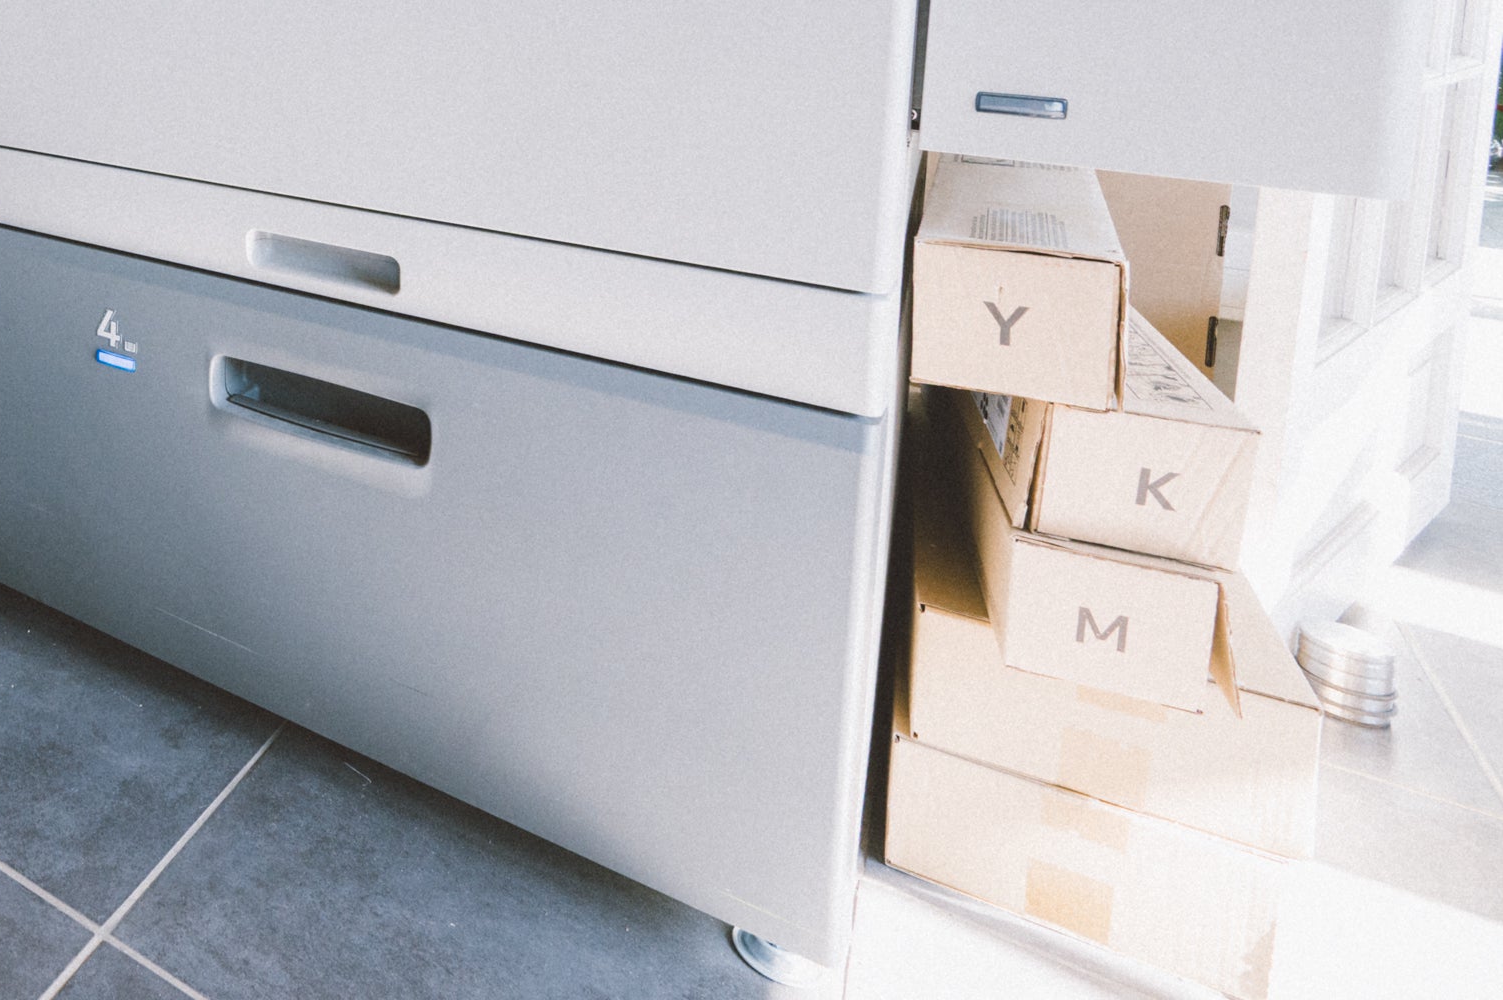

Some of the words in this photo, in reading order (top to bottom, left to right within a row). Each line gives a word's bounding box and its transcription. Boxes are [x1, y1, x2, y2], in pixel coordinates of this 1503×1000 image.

[95, 308, 123, 348] 4
[982, 300, 1030, 346] Y
[1134, 466, 1184, 513] K
[1076, 605, 1129, 653] M
